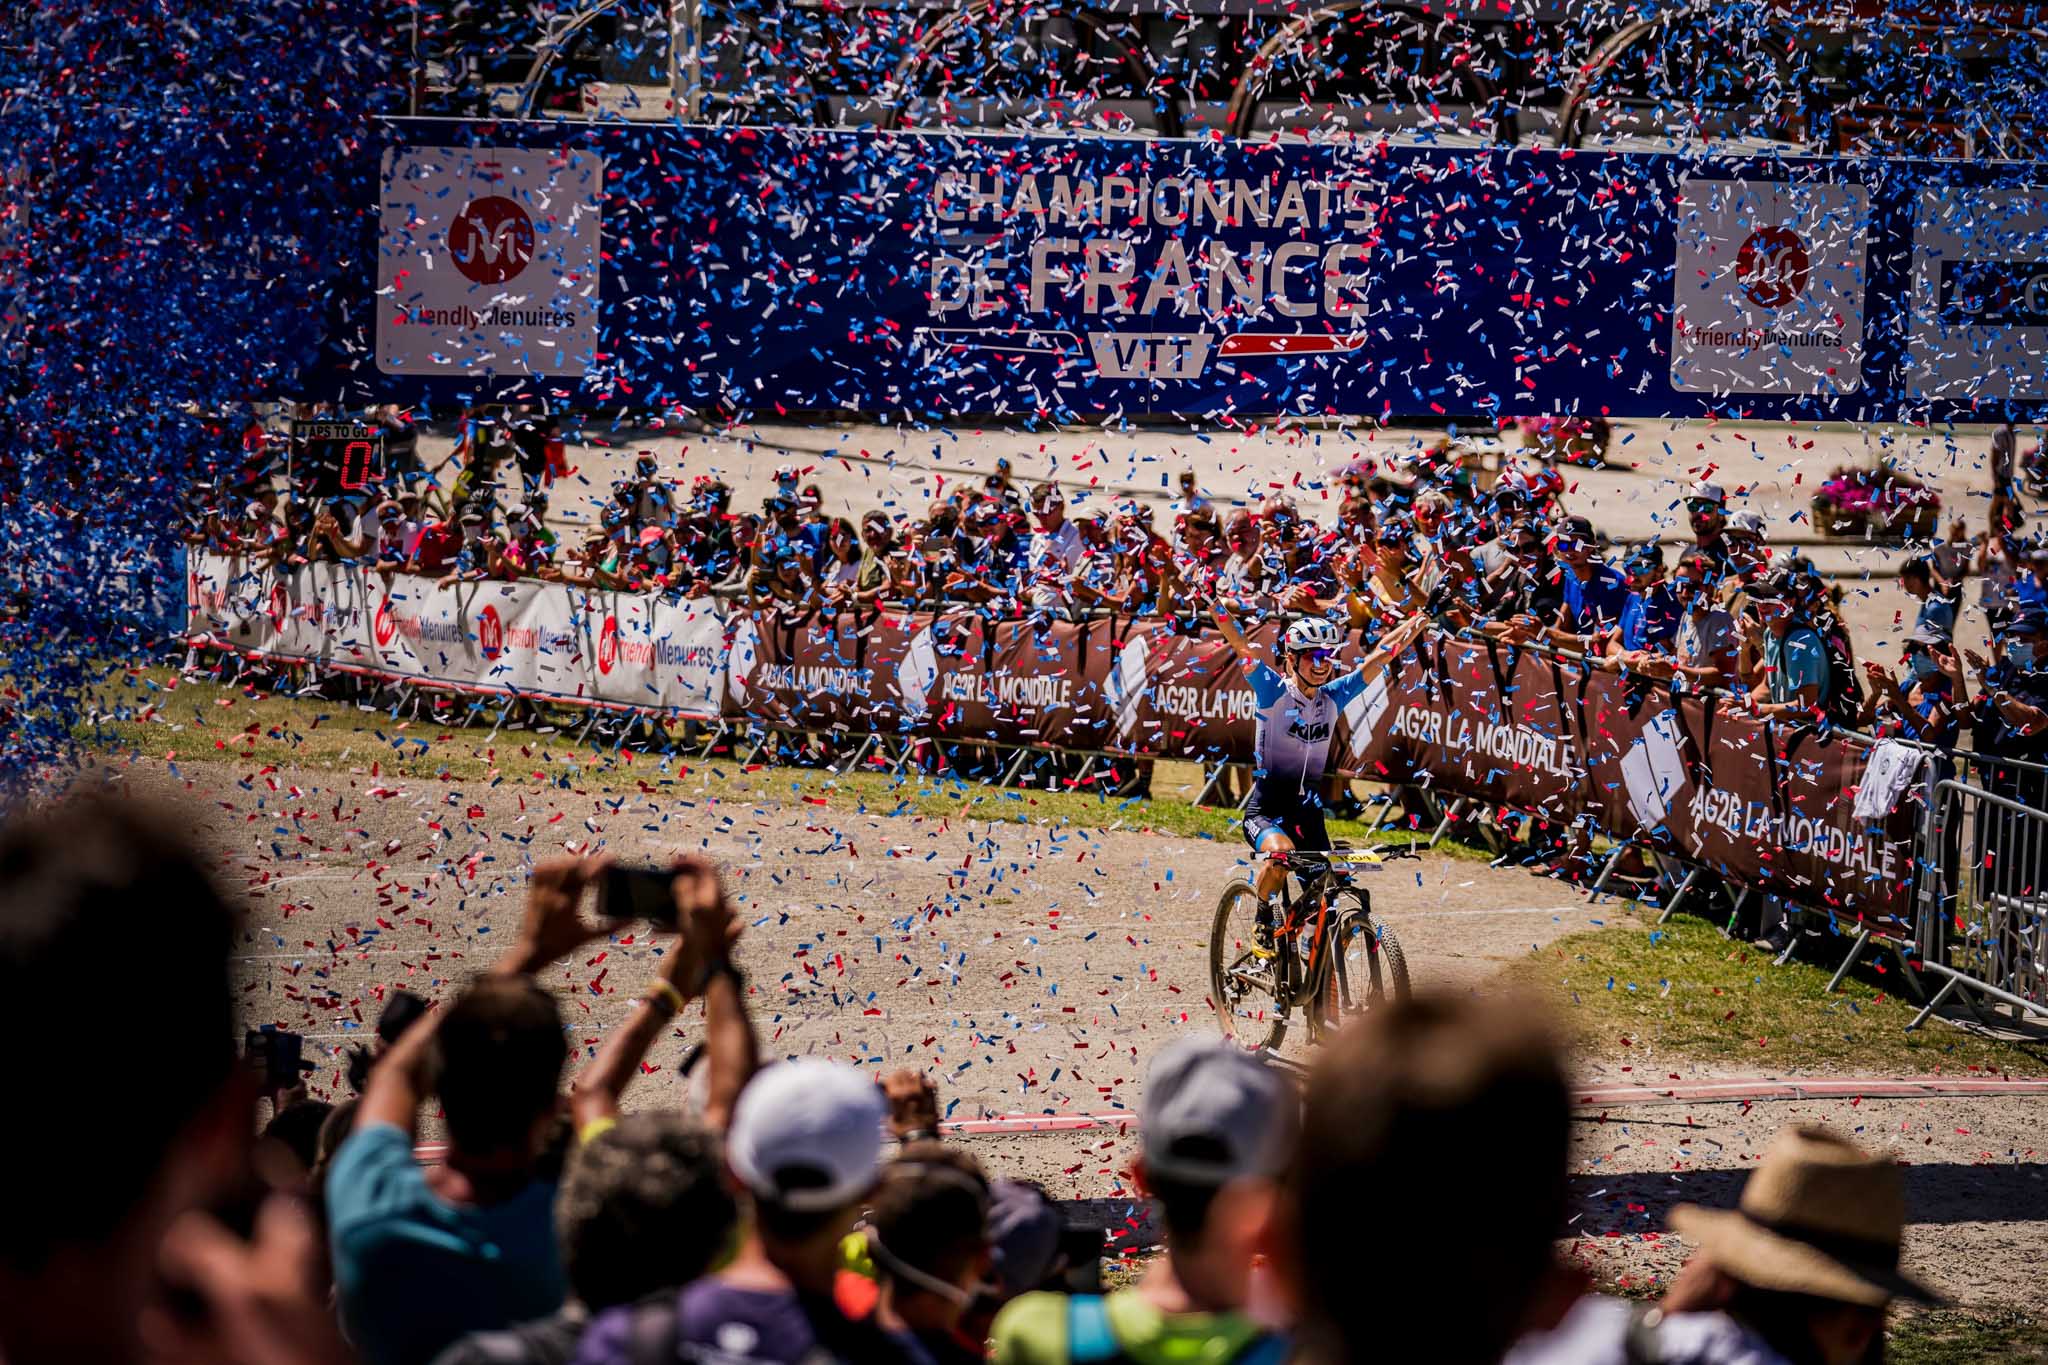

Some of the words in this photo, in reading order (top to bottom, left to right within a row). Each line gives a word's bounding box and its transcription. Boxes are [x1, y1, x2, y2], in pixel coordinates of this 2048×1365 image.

[934, 172, 1374, 230] CHAMPIONNATS
[930, 257, 1008, 311] DE
[1030, 238, 1372, 318] FRANCE
[1112, 338, 1192, 372] VTT
[334, 425, 349, 437] TO
[340, 441, 372, 490] 0
[942, 670, 976, 702] AG2R
[1001, 675, 1072, 709] MONDIALE
[1156, 684, 1199, 716] AG2R
[1202, 688, 1224, 719] LA
[1391, 705, 1442, 745] AG2R
[1445, 714, 1472, 751] LA
[1475, 720, 1576, 778] MONDIALE
[1690, 784, 1742, 832] AG2R
[1744, 801, 1772, 844] LA
[1776, 811, 1898, 880] MONDIALE
